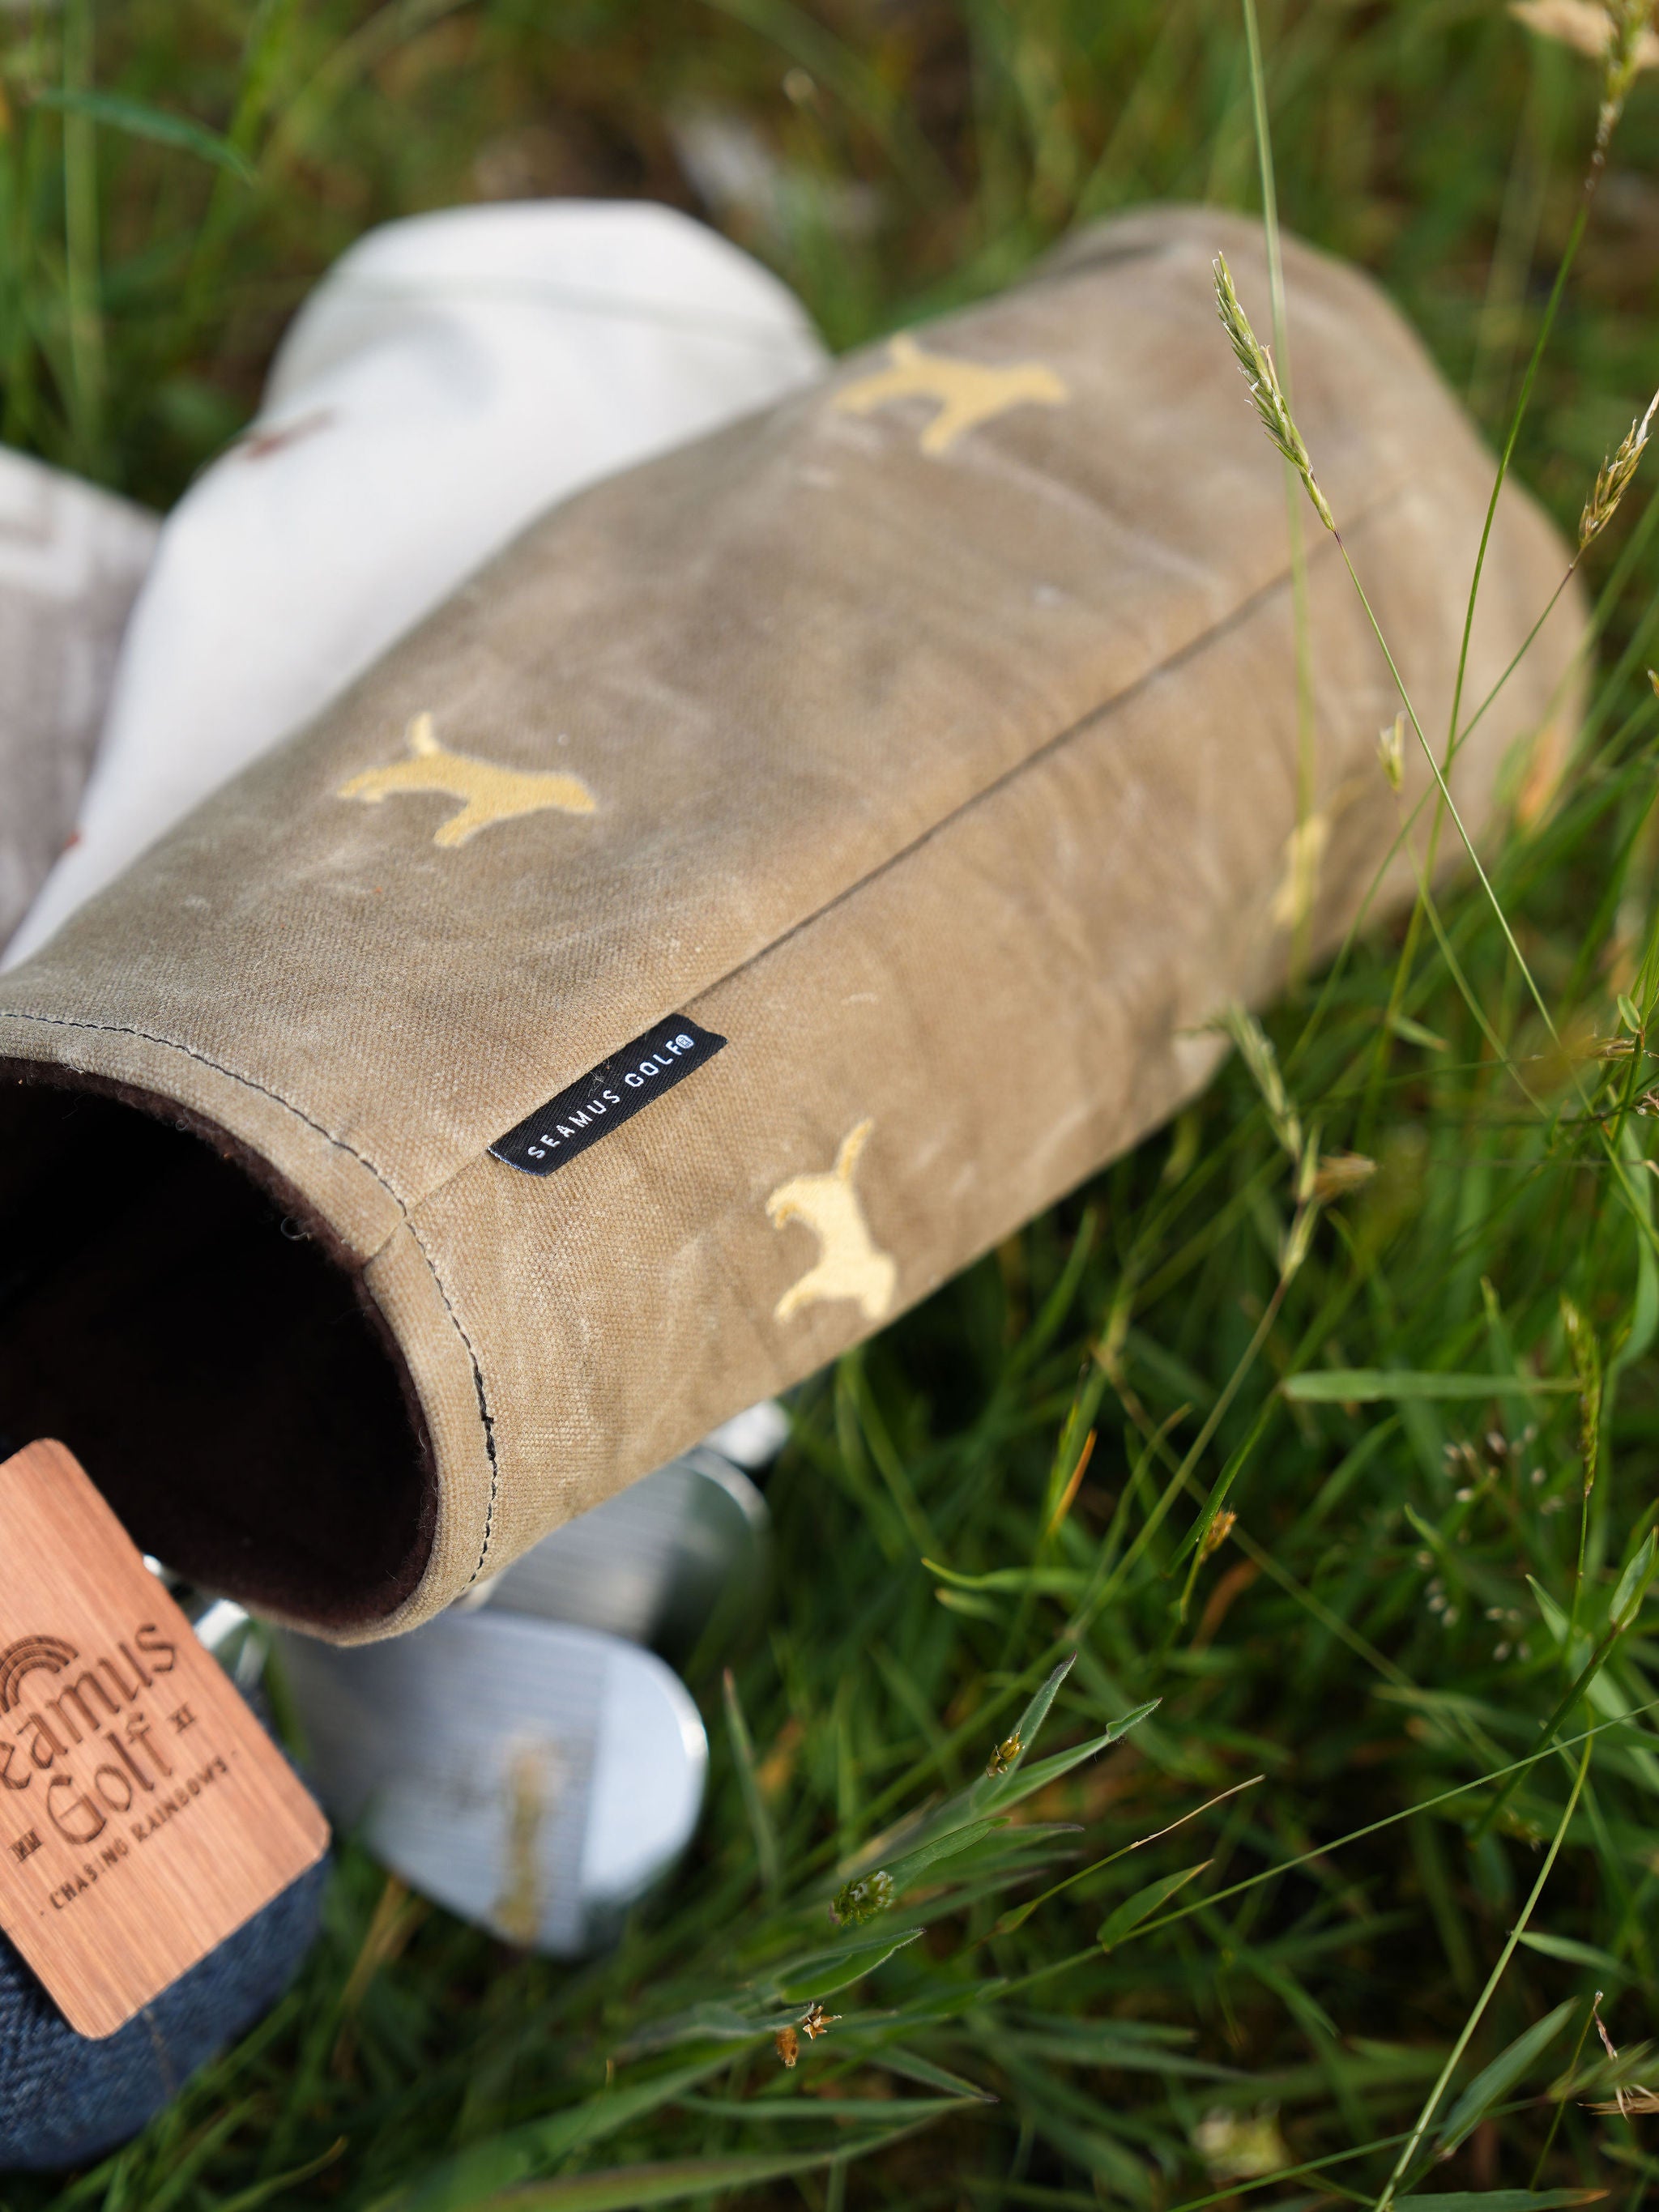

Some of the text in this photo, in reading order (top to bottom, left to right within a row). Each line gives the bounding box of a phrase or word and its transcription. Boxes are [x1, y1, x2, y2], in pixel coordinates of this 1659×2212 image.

[527, 1089, 621, 1159] SEAMUS
[46, 1711, 173, 1845] Golf
[49, 1755, 228, 1910] CHASING RAINBOWS
